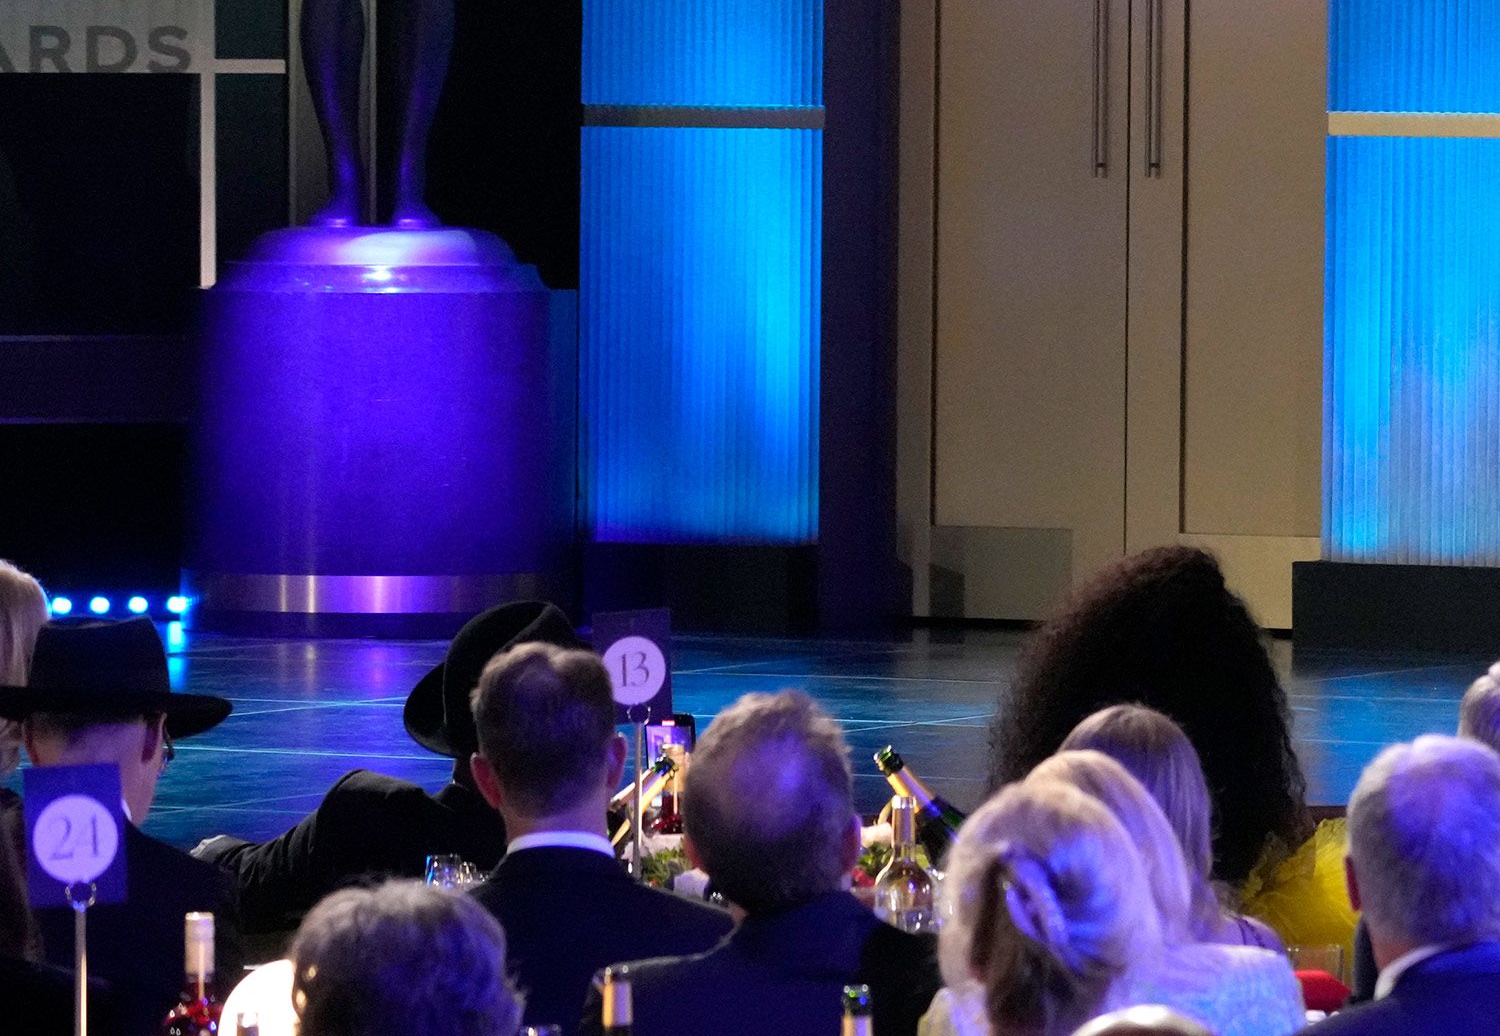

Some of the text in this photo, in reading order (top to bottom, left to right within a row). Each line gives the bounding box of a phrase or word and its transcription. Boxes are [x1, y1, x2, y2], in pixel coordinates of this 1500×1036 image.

[0, 25, 191, 73] RDS
[619, 651, 650, 688] 13
[48, 813, 99, 861] 24
